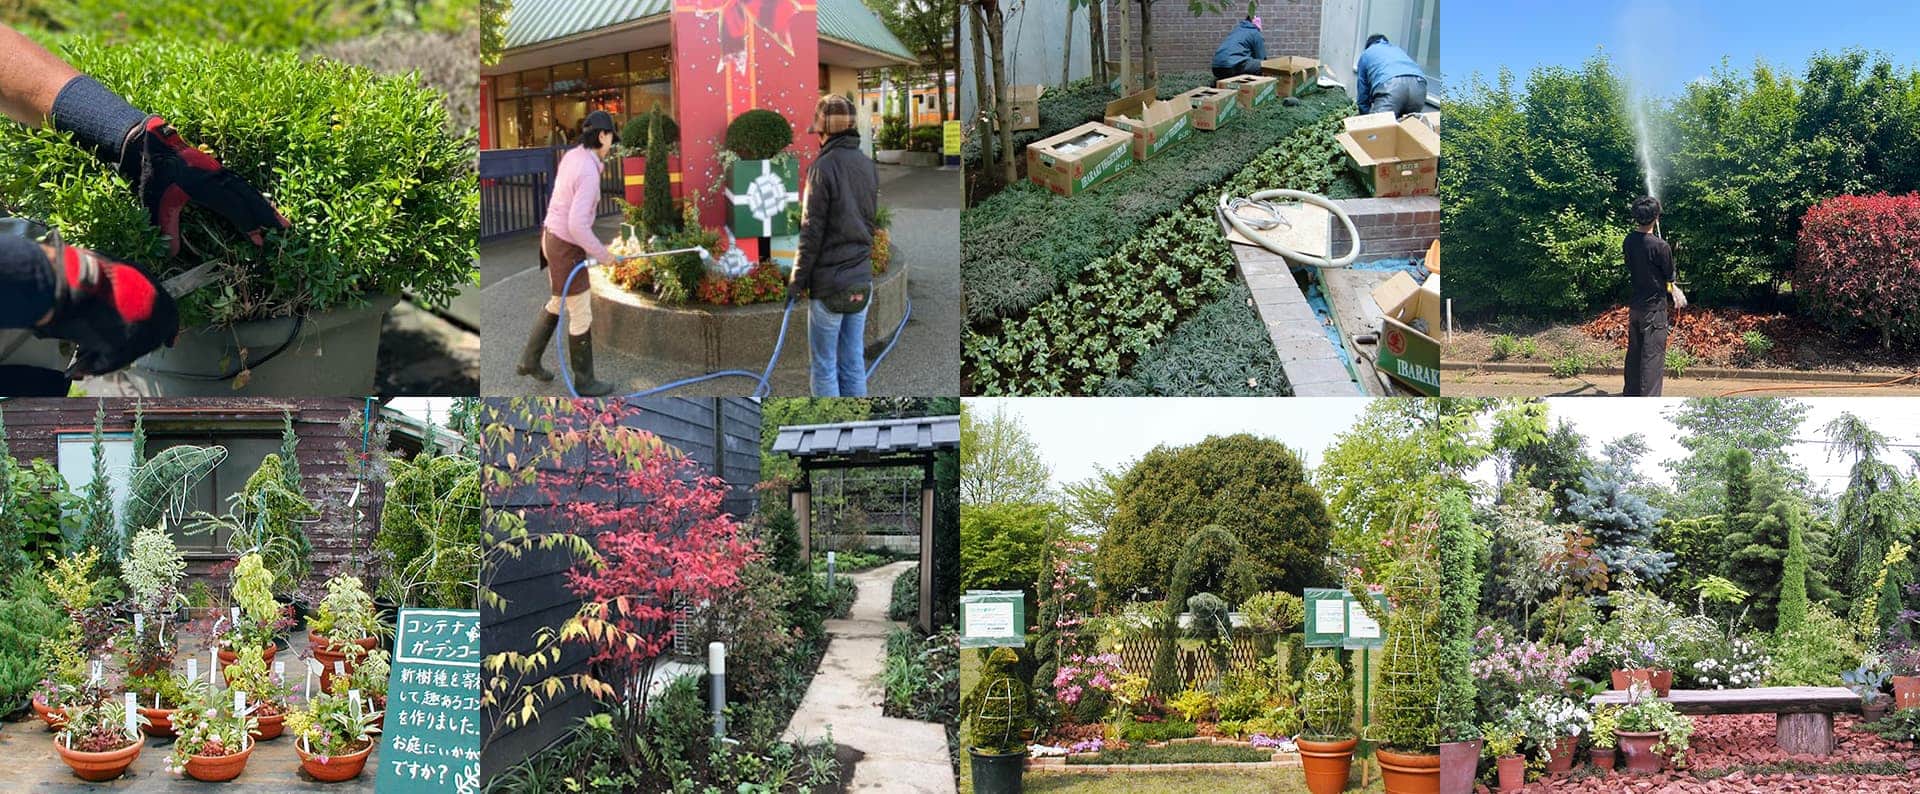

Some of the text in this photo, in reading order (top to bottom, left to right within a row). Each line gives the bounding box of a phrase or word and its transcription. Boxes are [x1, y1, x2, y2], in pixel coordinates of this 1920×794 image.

[407, 620, 464, 635] コンテナ
[411, 639, 480, 658] ガーデンコー
